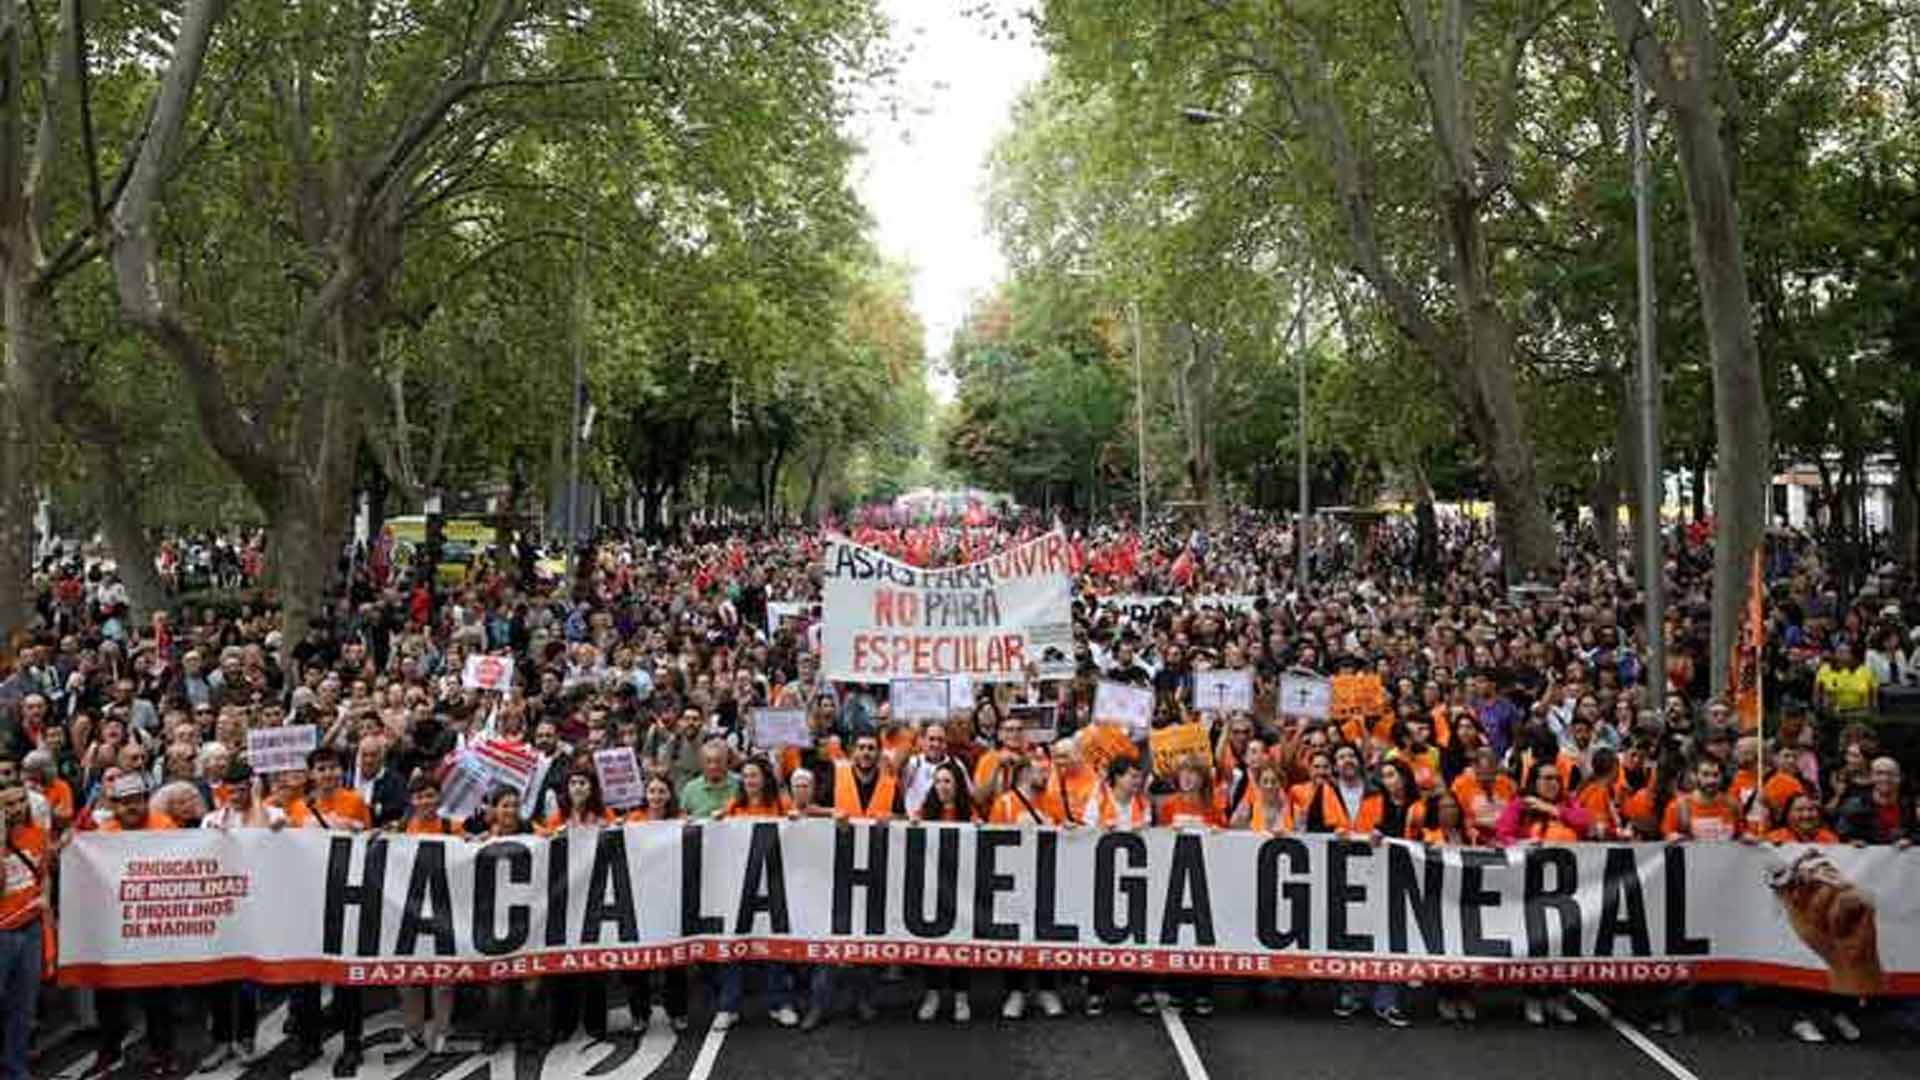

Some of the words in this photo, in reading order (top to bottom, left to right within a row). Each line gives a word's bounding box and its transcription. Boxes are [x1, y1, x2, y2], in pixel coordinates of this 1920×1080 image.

[872, 588, 919, 627] NO
[924, 589, 1000, 627] PARA
[853, 633, 1026, 673] ESPECULAR
[127, 858, 219, 876] SINDICATO
[123, 881, 147, 898] DE
[149, 876, 249, 898] INQUILINAS
[321, 829, 640, 958] HACIA
[681, 822, 791, 937] LA
[832, 821, 1217, 947] HUELGA
[1255, 837, 1710, 959] GENERAL
[123, 903, 134, 919] E
[136, 899, 235, 918] INQUILINOS
[122, 922, 143, 938] DE
[146, 919, 216, 937] MADRID
[349, 959, 475, 982] BAJADA
[489, 958, 547, 977] DEL
[561, 943, 705, 969] ALQUILER
[718, 942, 769, 958] 50%
[807, 942, 1025, 964] EXPROPIACION
[1038, 950, 1154, 969] FONDOS
[1168, 953, 1272, 971] BUITRE
[1308, 958, 1481, 978] CONTRATOS
[1498, 963, 1691, 981] INDEFINIDOS
